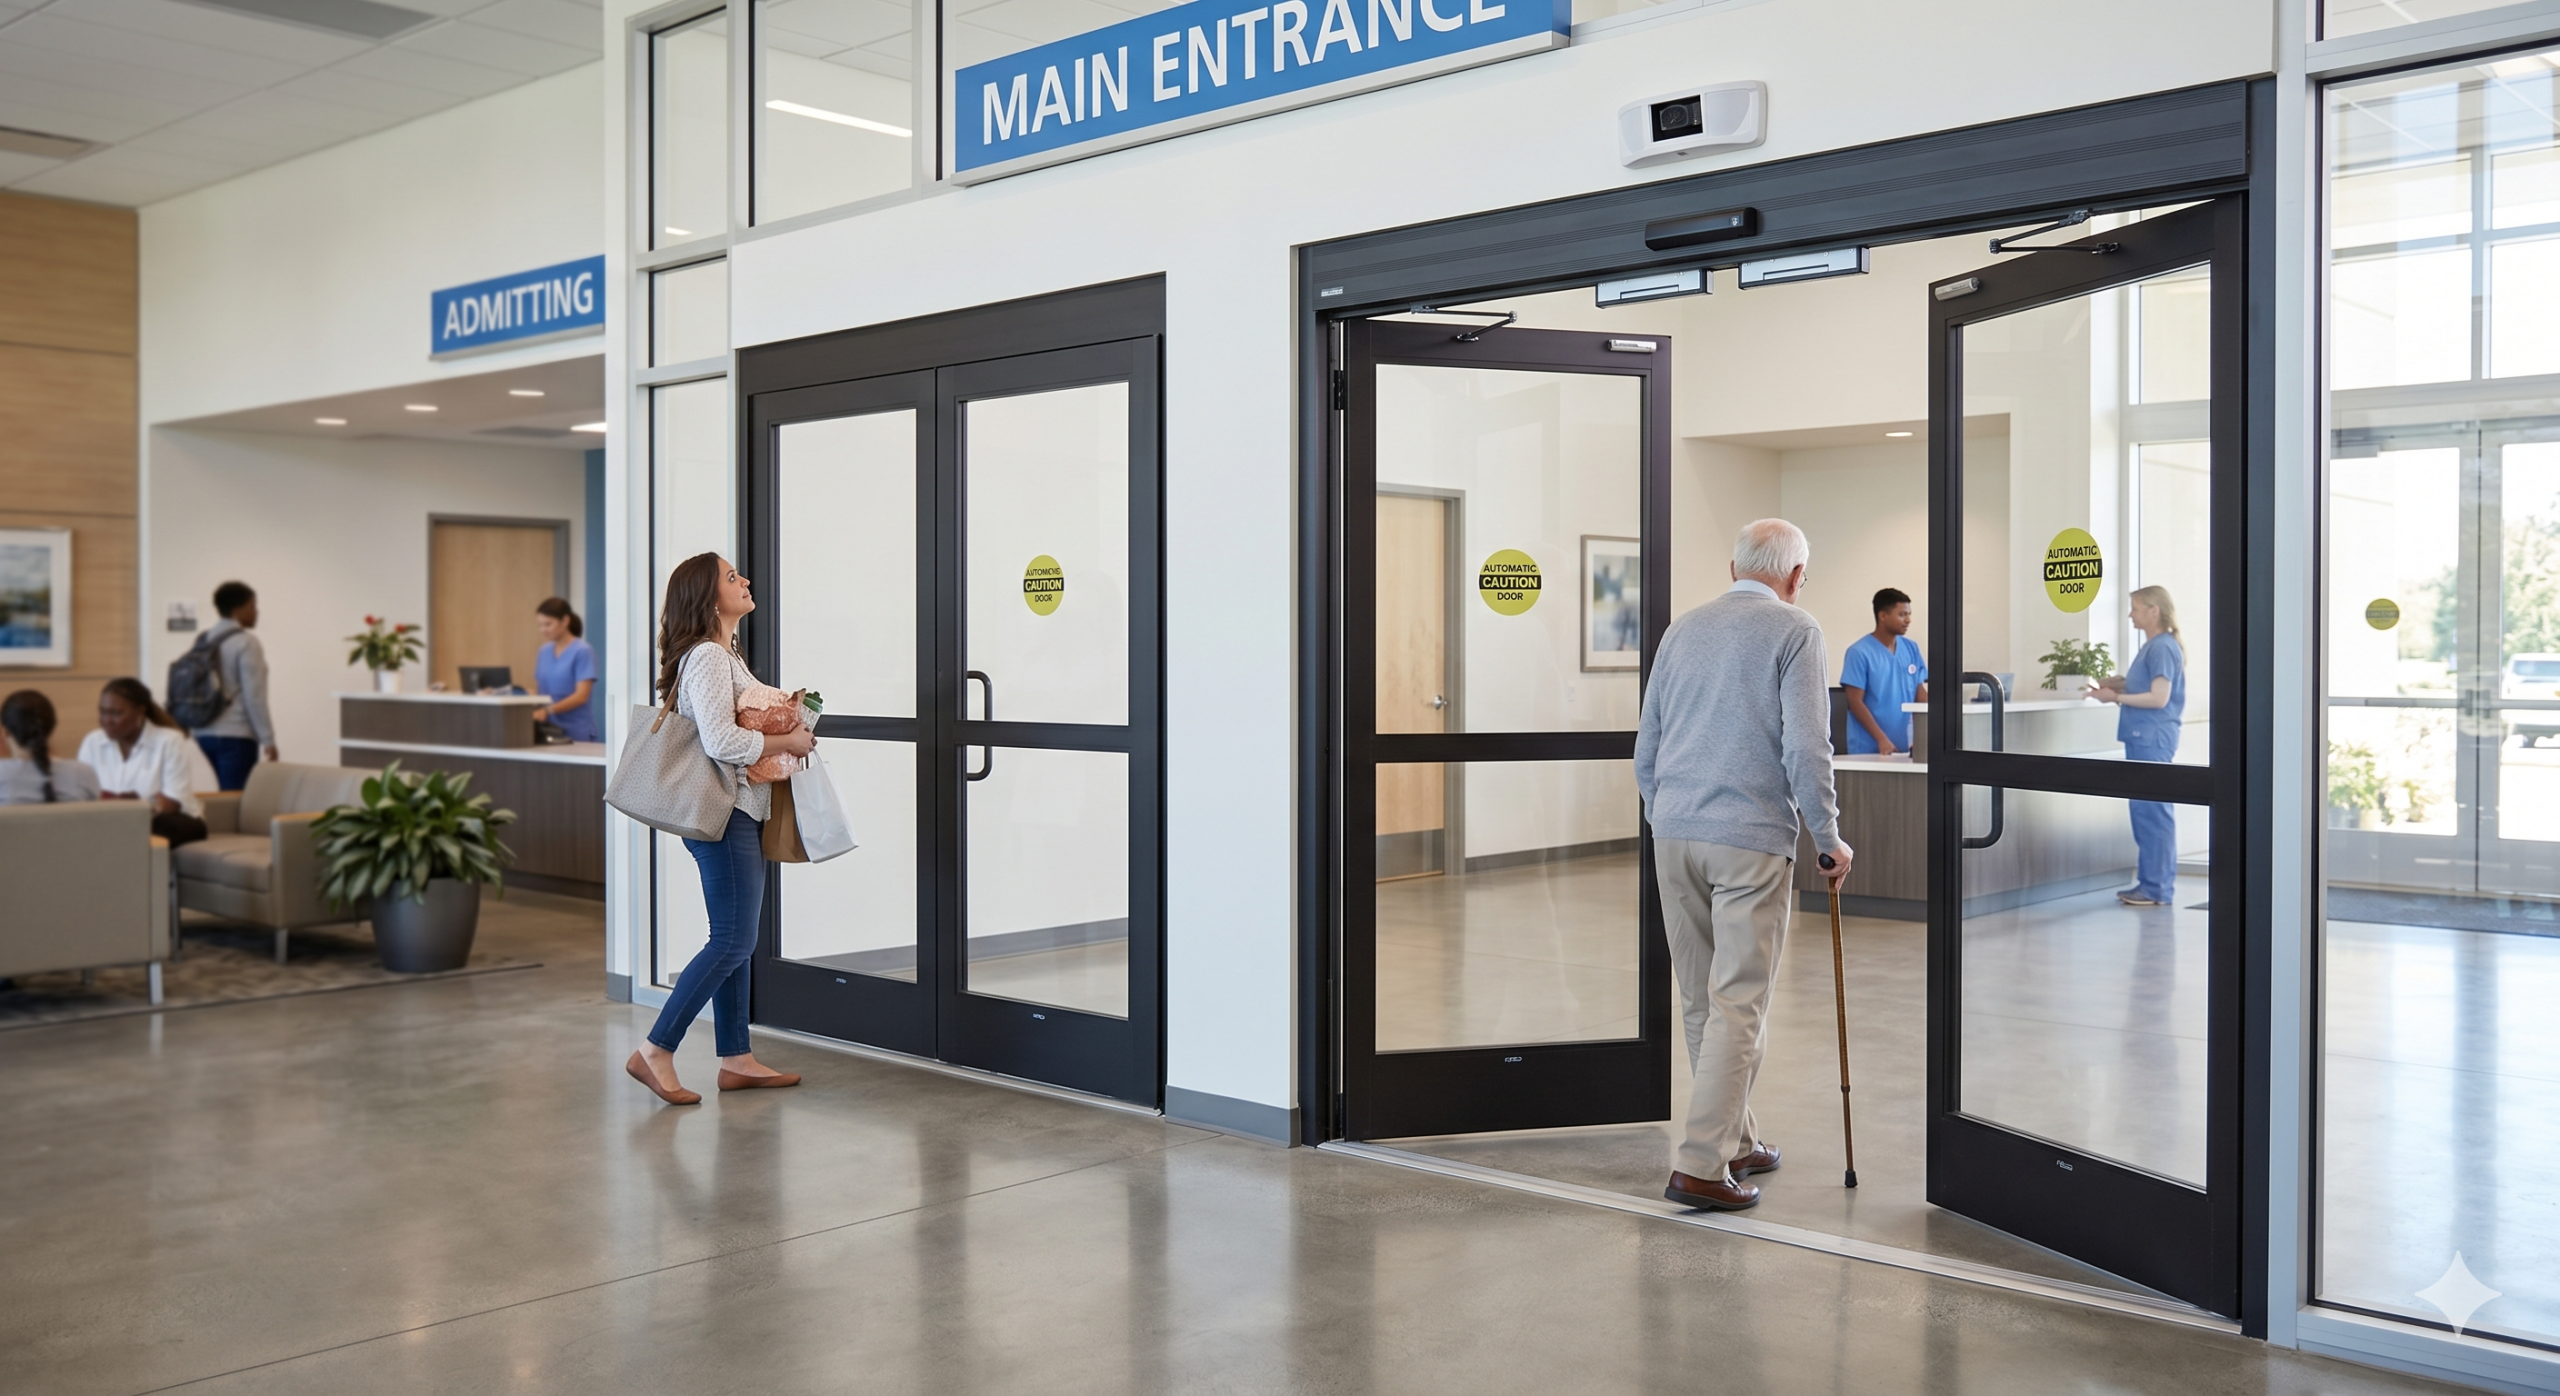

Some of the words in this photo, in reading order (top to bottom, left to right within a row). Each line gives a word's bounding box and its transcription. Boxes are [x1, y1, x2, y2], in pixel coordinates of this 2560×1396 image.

[983, 46, 1128, 145] MAIN
[443, 272, 593, 340] ADMITTING
[2047, 545, 2098, 559] AUTOMATIC
[1483, 564, 1537, 573] AUTOMATIC
[2046, 561, 2099, 578] CAUTION
[1025, 579, 1063, 591] CAUTION
[1482, 576, 1538, 588] CAUTION
[2060, 583, 2085, 594] DOOR
[1497, 592, 1524, 600] DOOR
